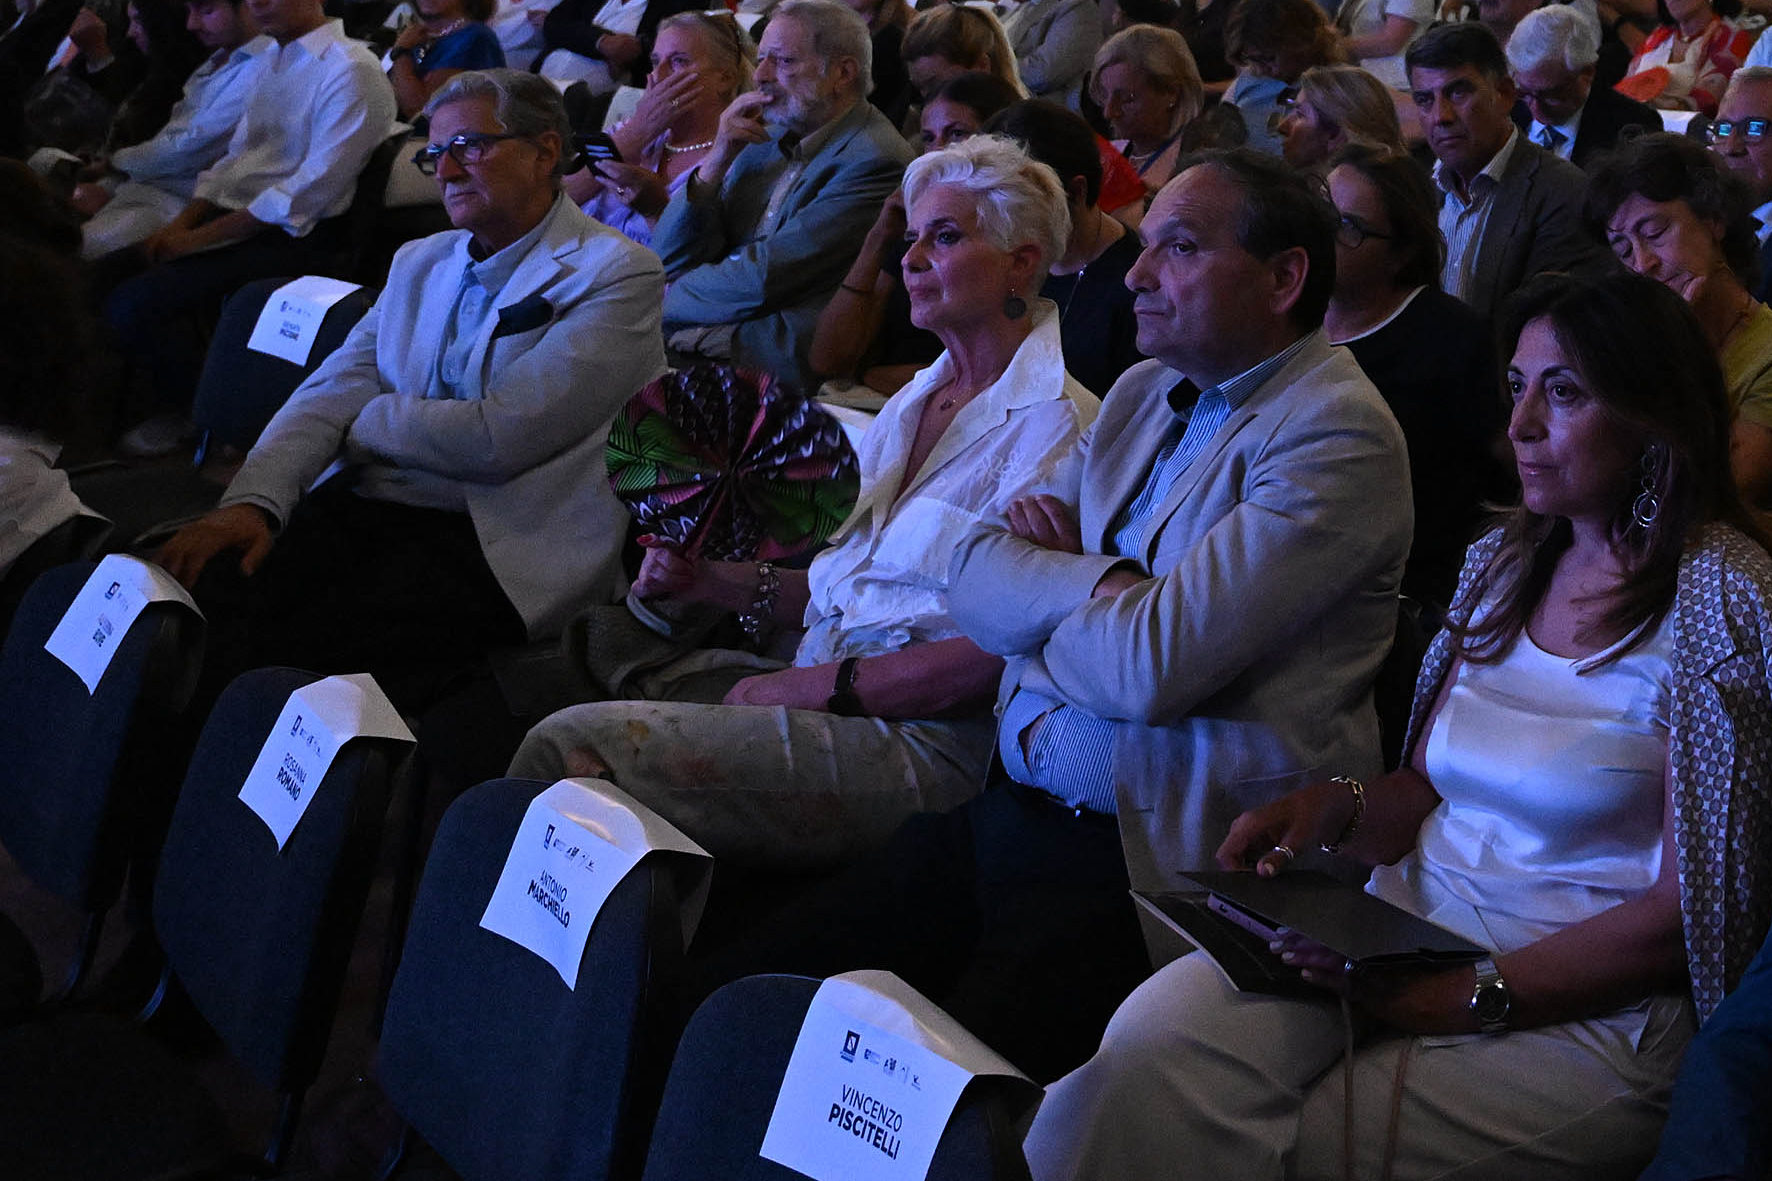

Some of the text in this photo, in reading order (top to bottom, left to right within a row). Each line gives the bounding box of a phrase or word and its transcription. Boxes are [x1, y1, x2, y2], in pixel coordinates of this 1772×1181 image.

[276, 765, 302, 801] ROMANO
[527, 880, 570, 928] MARCHIELLO
[539, 869, 568, 903] ANTONIO
[828, 1103, 902, 1160] PISCITELLI
[842, 1083, 903, 1133] VINCENZO
